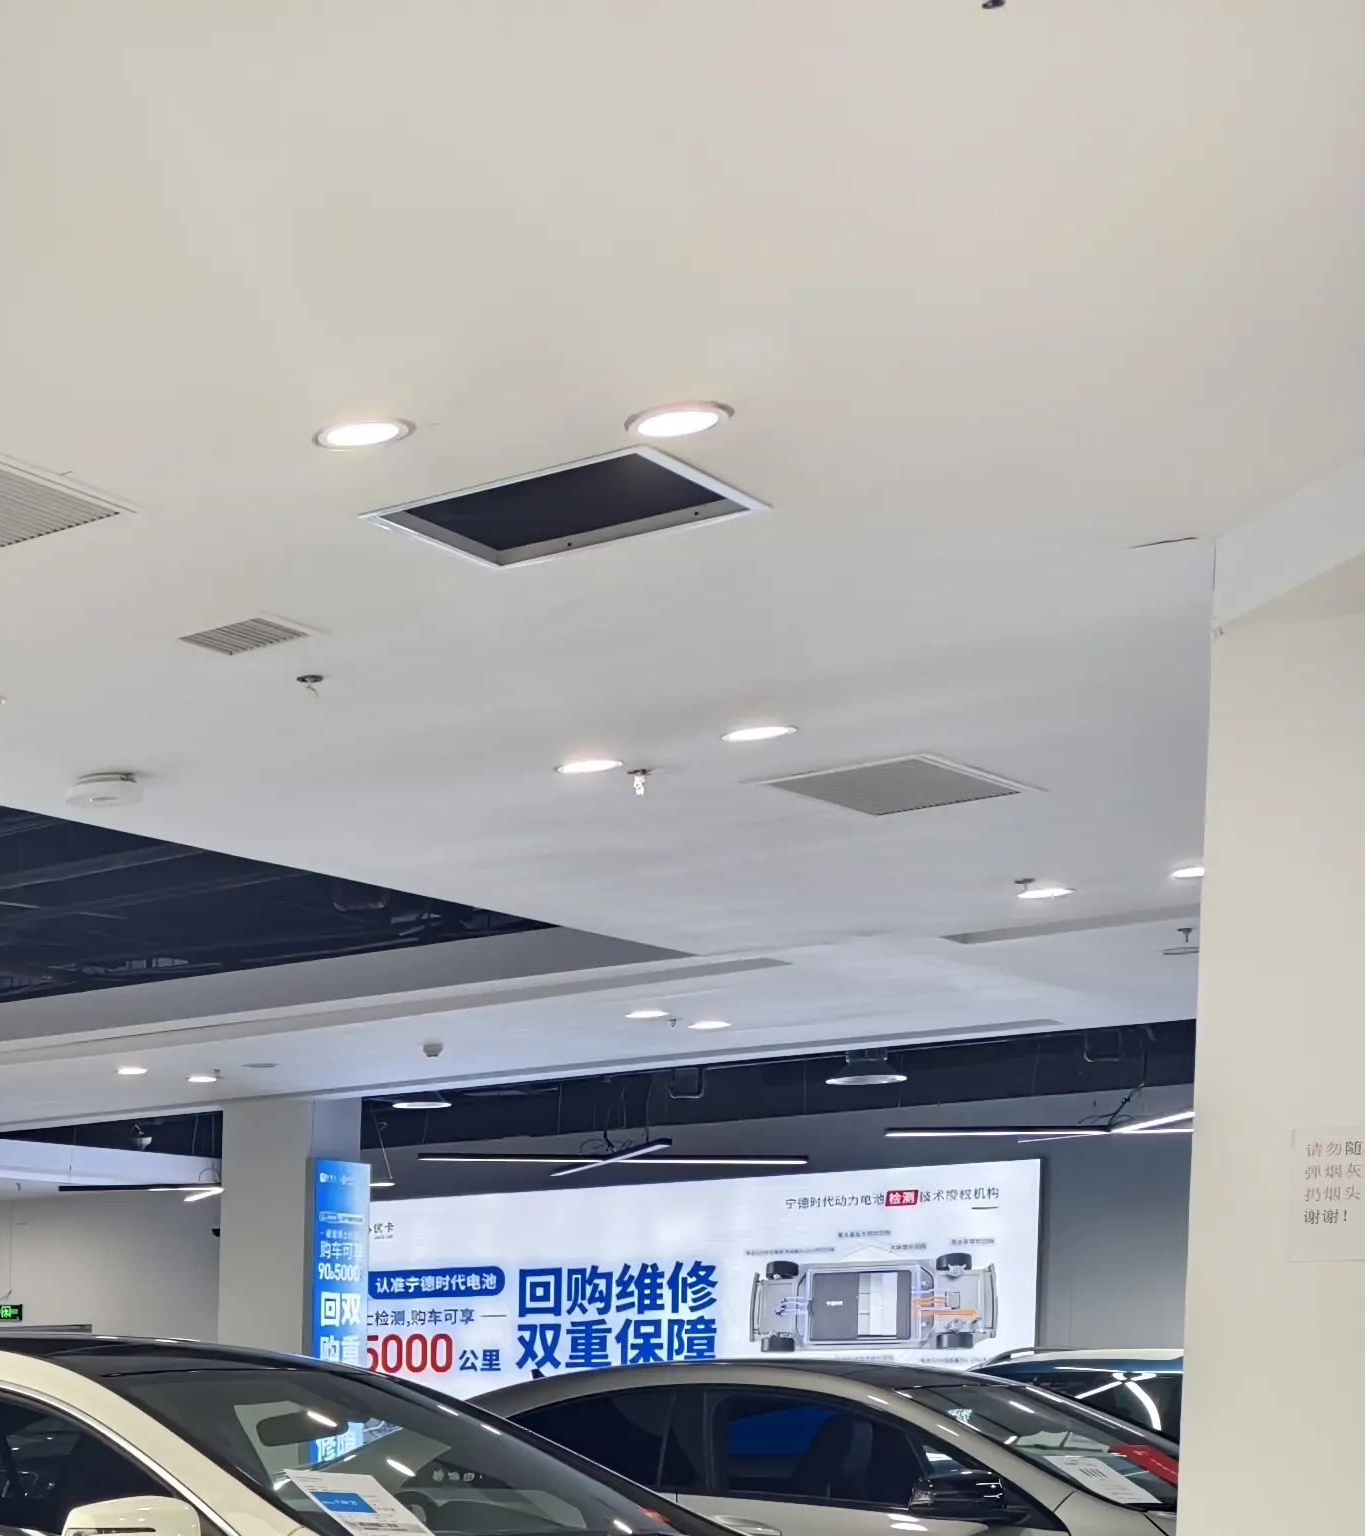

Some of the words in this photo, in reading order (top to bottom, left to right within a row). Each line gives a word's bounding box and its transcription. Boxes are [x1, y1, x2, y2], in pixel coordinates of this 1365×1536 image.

[1305, 1162, 1362, 1180] 弹烟灰
[1304, 1185, 1361, 1202] 扔烟头
[375, 1273, 498, 1294] 认准宁德时代电池
[518, 1261, 718, 1317] 回购维修
[515, 1316, 718, 1370] 双重保障
[458, 1349, 501, 1373] 公里
